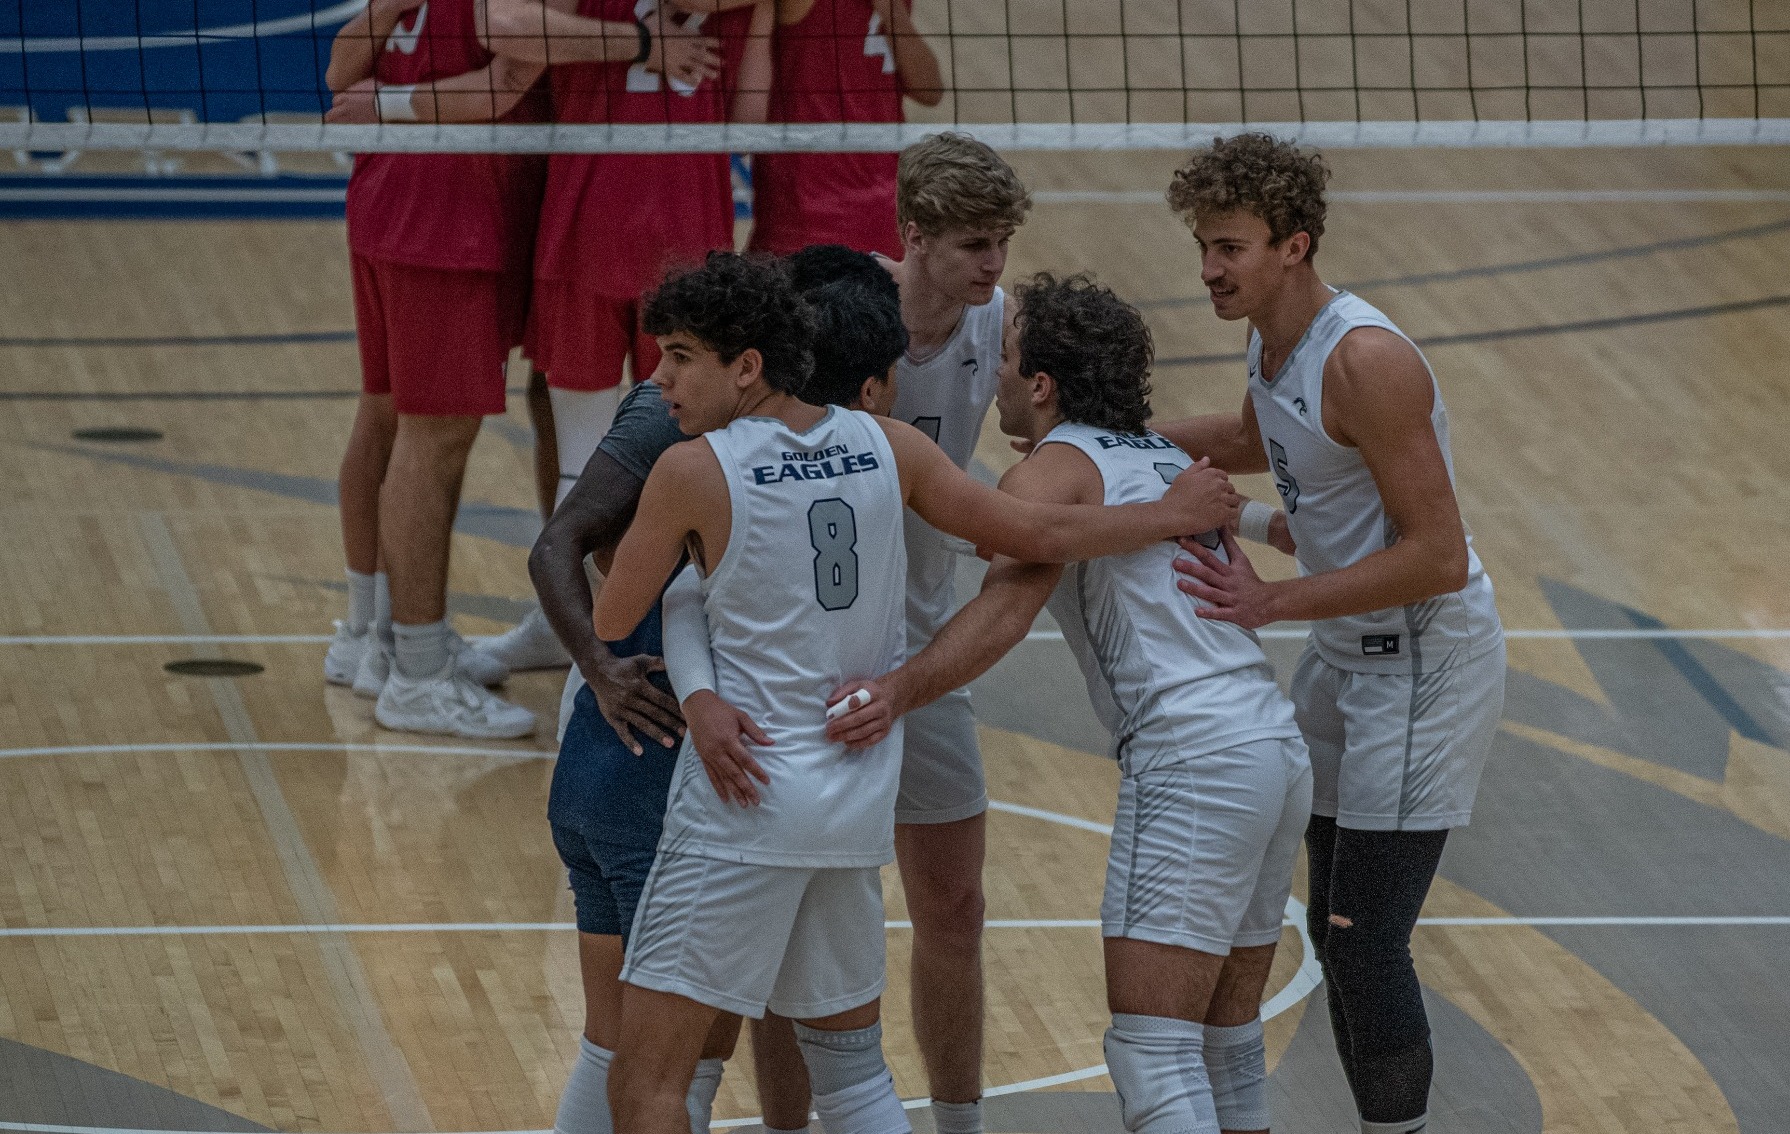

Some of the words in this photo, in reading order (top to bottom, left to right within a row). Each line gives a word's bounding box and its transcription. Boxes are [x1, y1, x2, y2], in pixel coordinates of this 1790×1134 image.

[781, 444, 849, 462] GOLDEN
[1094, 436, 1185, 454] EAGLE
[752, 452, 879, 485] EAGLES
[1269, 437, 1300, 515] 5
[807, 497, 858, 611] 8
[1386, 640, 1394, 649] M
